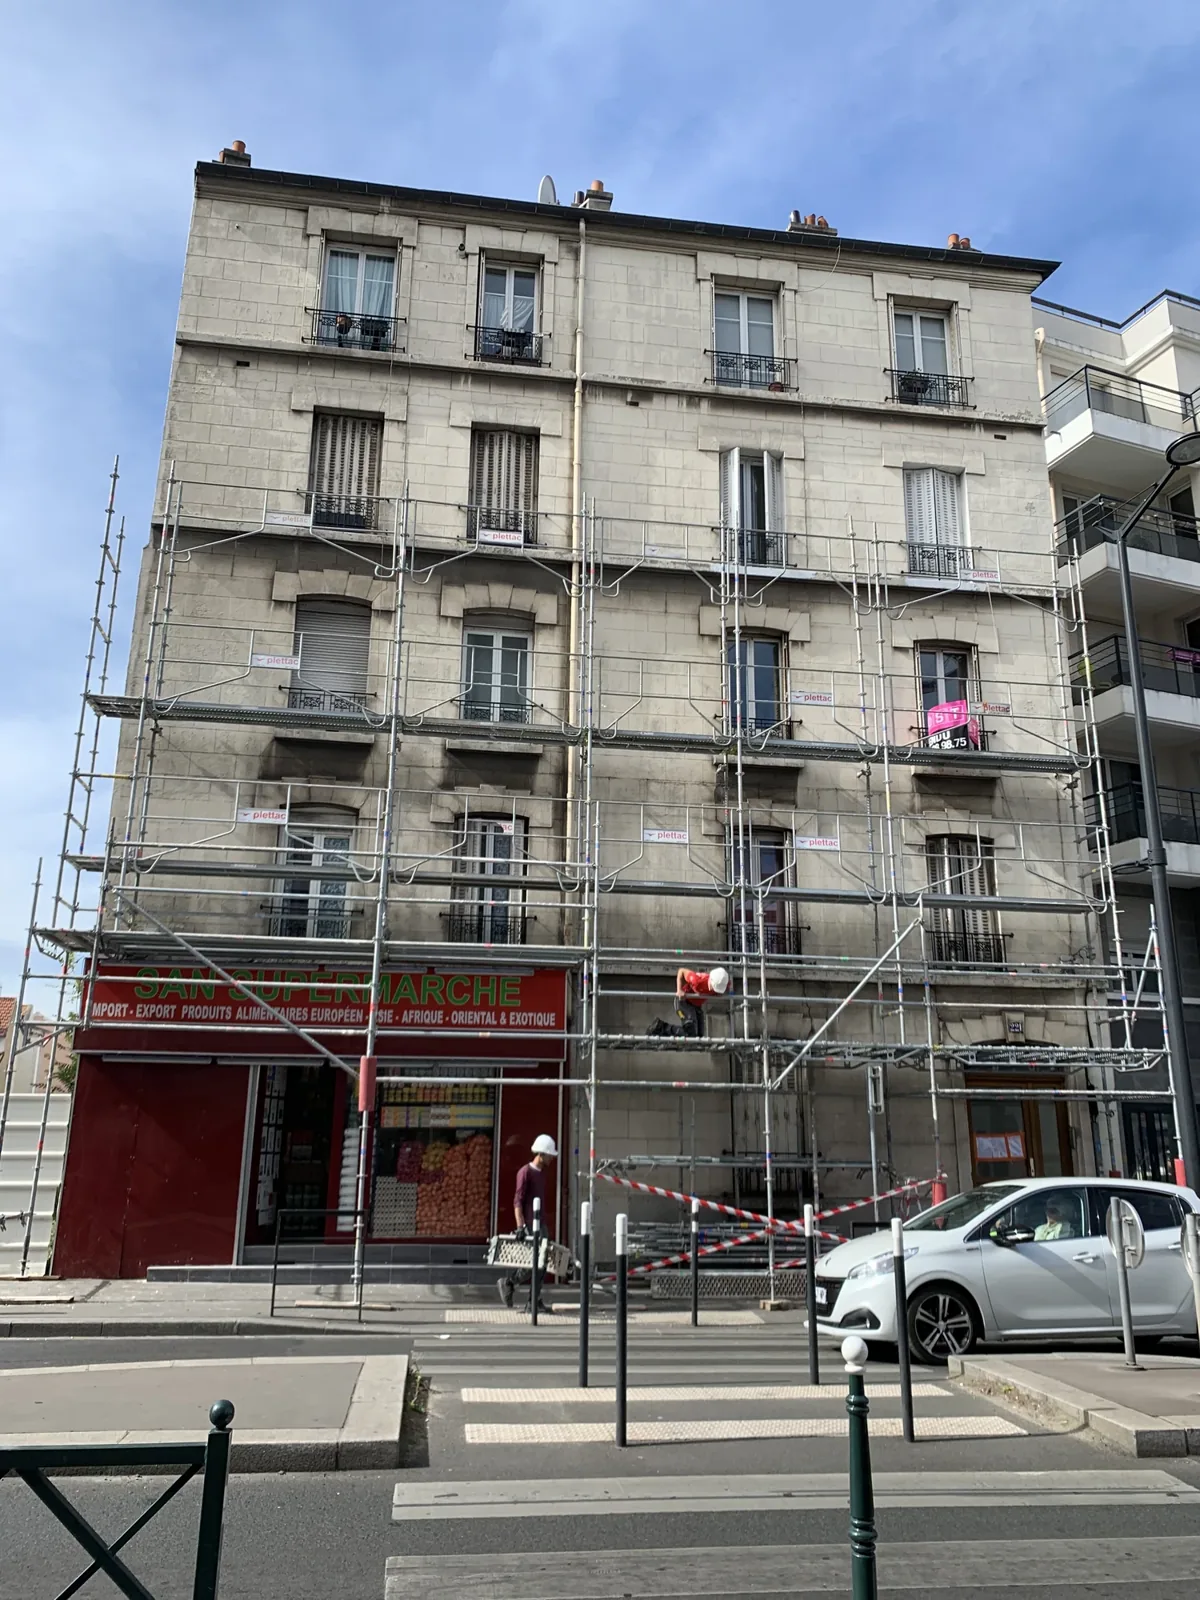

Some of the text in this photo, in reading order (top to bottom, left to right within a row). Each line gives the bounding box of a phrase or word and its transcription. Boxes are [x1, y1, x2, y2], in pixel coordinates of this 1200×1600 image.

[492, 533, 521, 541] plettac
[972, 571, 999, 579] plettac
[266, 656, 299, 666] plettac
[804, 694, 832, 702] plettac
[253, 811, 286, 820] plettac
[657, 831, 687, 840] plettac
[809, 838, 838, 847] plettac
[133, 966, 521, 1007] SAN SUPERMARCHE
[91, 1002, 129, 1017] MPORT
[135, 1003, 177, 1019] EXPORT
[181, 1004, 232, 1021] PRODUITS
[310, 1005, 364, 1024] EUROPÉEN
[374, 1009, 394, 1024] SIE
[401, 1009, 444, 1025] AFRIQUE
[451, 1010, 498, 1026] ORIENTAL
[499, 1011, 507, 1026] &
[509, 1011, 556, 1027] EXOTIQUE
